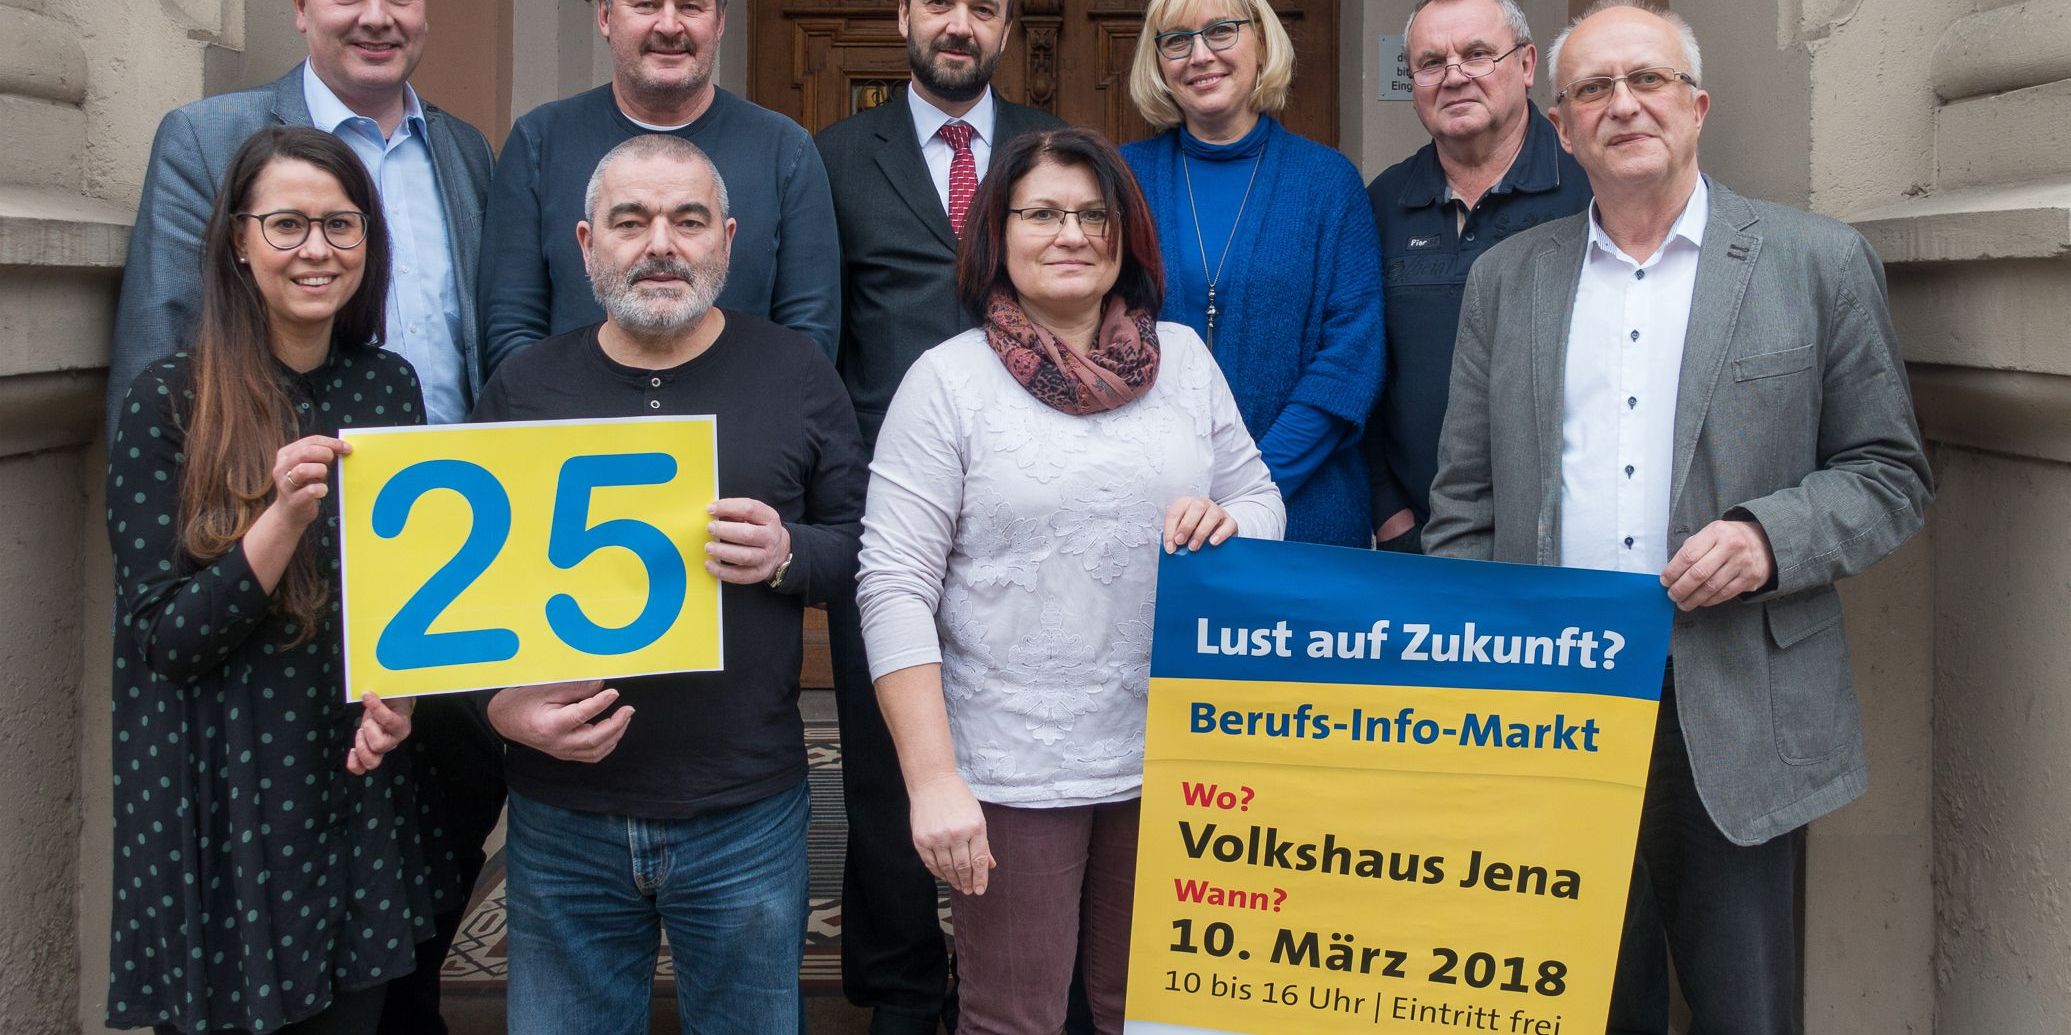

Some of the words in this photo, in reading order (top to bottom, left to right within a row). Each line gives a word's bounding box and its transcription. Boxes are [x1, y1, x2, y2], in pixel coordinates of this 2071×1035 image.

[372, 453, 687, 670] 25
[1198, 618, 1293, 658] Lust
[1307, 620, 1390, 660] auf
[1401, 623, 1626, 670] Zukunft?
[1190, 703, 1600, 753] Berufs-Info-Markt
[1182, 782, 1255, 812] Wo?
[1178, 821, 1445, 885] Volkshaus
[1460, 851, 1581, 900] Jena
[1174, 879, 1288, 912] Wann?
[1169, 919, 1251, 960] 10.
[1270, 929, 1408, 979] März
[1428, 948, 1568, 997] 2018
[1165, 971, 1201, 994] 10
[1212, 974, 1252, 1001] bis
[1263, 983, 1299, 1006] 16
[1310, 987, 1366, 1014] Uhr
[1393, 997, 1501, 1031] Eintritt
[1510, 1010, 1563, 1035] frei
